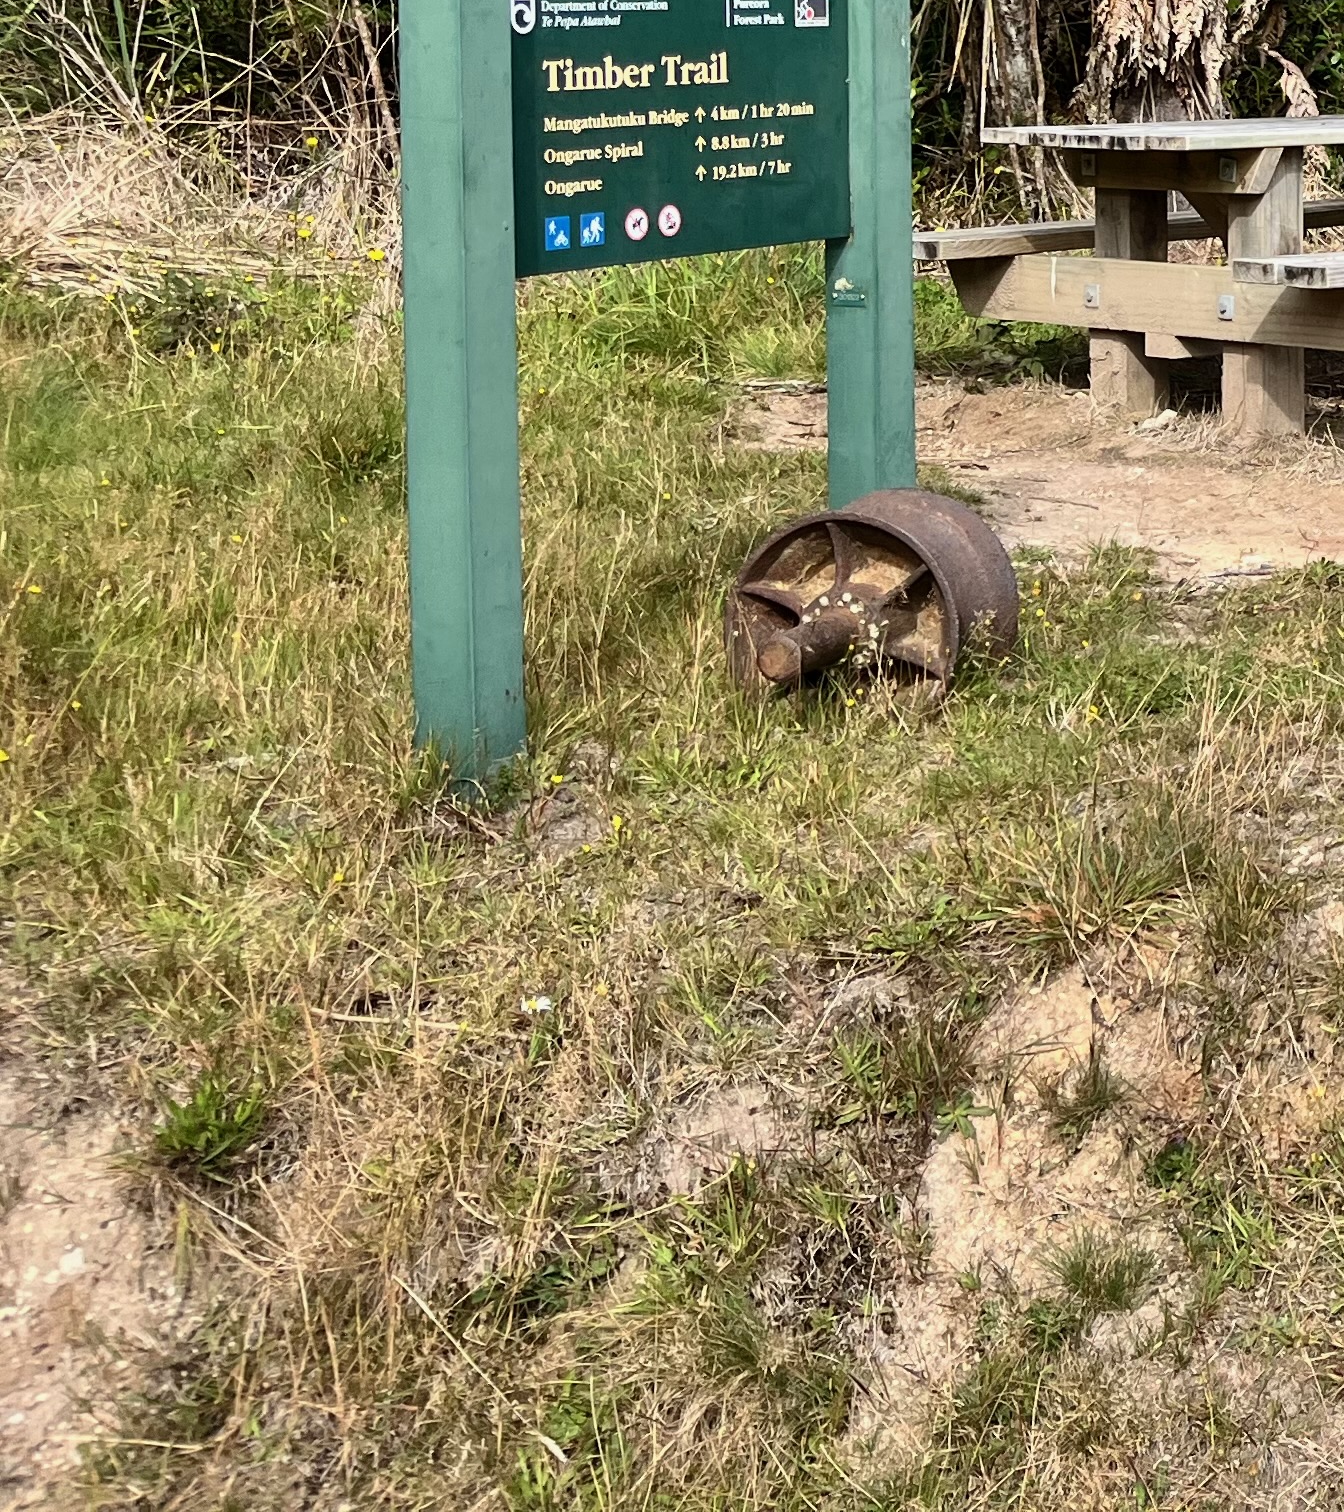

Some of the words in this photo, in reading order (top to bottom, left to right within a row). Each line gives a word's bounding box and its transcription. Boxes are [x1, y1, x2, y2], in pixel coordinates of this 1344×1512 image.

[541, 0, 596, 15] Department
[598, 0, 608, 11] of
[610, 0, 669, 11] Conservation
[542, 15, 553, 28] Te
[554, 16, 579, 30] Papa
[733, 14, 762, 26] Forest
[763, 12, 785, 25] Park
[542, 55, 655, 92] Timber
[660, 51, 729, 86] Trail
[543, 112, 646, 135] Mangatukutuku
[648, 108, 689, 127] Bridge
[710, 105, 719, 121] 4
[720, 105, 740, 120] km
[751, 104, 757, 119] 1
[760, 103, 774, 118] hr
[776, 102, 790, 117] 20
[791, 101, 814, 116] min
[543, 148, 602, 167] Ongarue
[604, 140, 644, 163] Spiral
[711, 136, 730, 151] 8.8
[730, 134, 750, 149] km
[761, 132, 769, 149] 3
[769, 131, 785, 146] hr
[544, 179, 603, 198] Ongarue
[712, 165, 737, 181] 19.2
[737, 162, 757, 178] km
[767, 161, 776, 175] 7
[776, 159, 792, 174] hr
